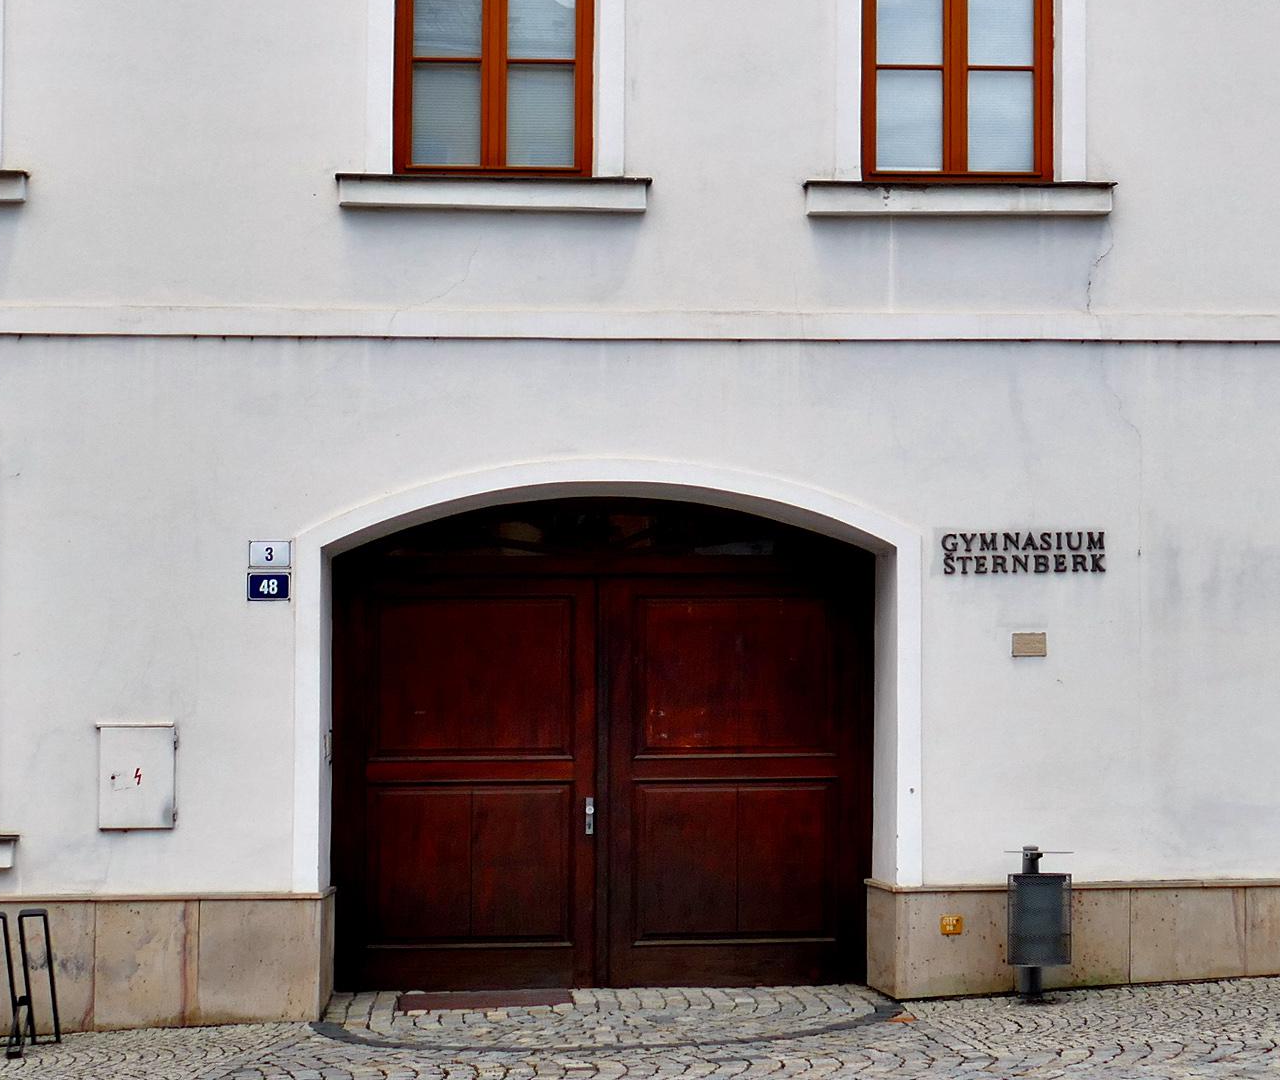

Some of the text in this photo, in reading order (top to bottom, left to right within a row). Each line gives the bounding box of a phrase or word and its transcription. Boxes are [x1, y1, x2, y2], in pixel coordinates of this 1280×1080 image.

[940, 531, 1106, 552] GYMNASIUM
[265, 546, 274, 562] 3
[943, 552, 1107, 575] ŠTERNBERK
[259, 579, 278, 595] 48
